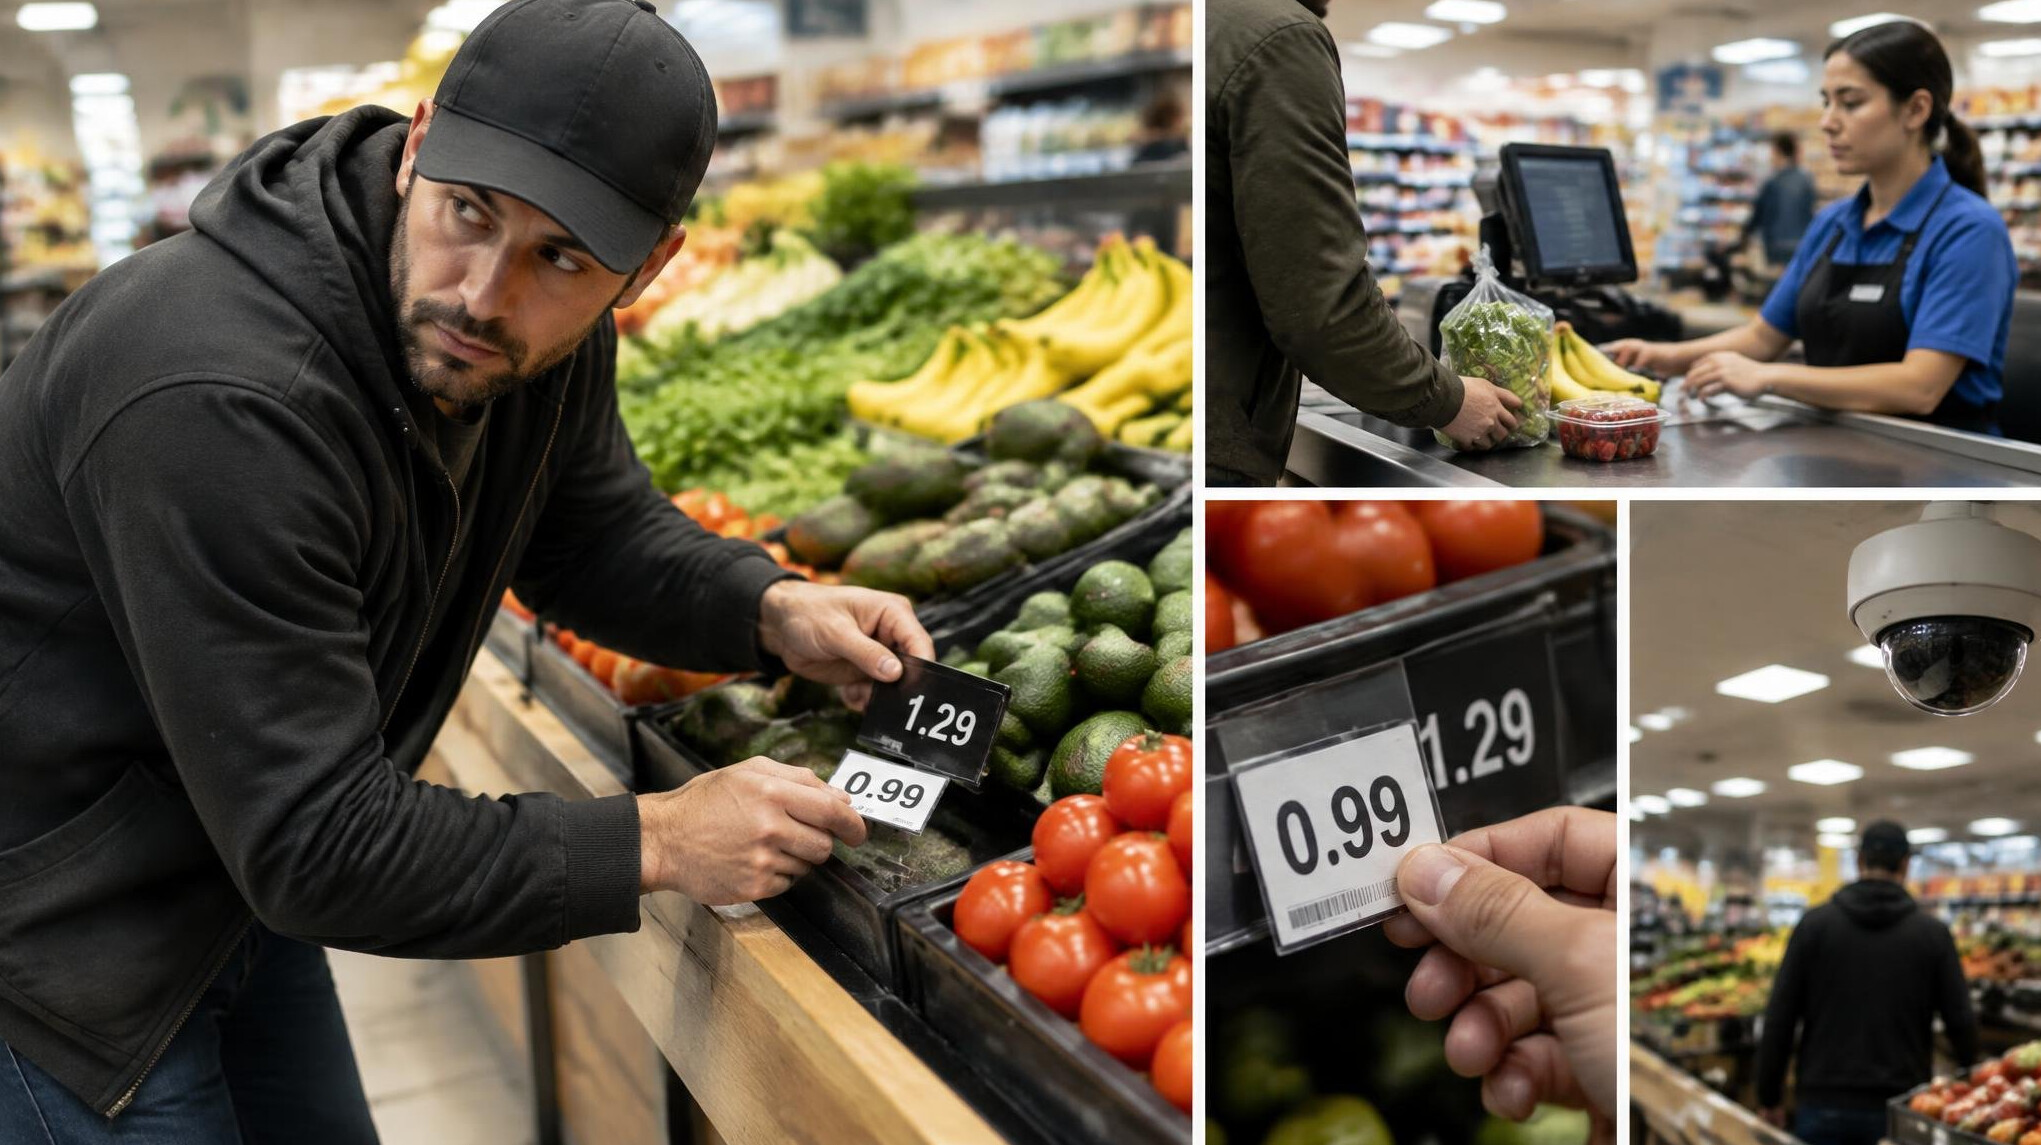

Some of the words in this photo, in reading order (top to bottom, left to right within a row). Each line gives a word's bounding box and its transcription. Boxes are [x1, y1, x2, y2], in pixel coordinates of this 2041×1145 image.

[904, 694, 977, 746] 1.29
[1417, 688, 1535, 790] 1.29
[844, 771, 925, 809] 0.99
[1276, 775, 1411, 876] 0.99
